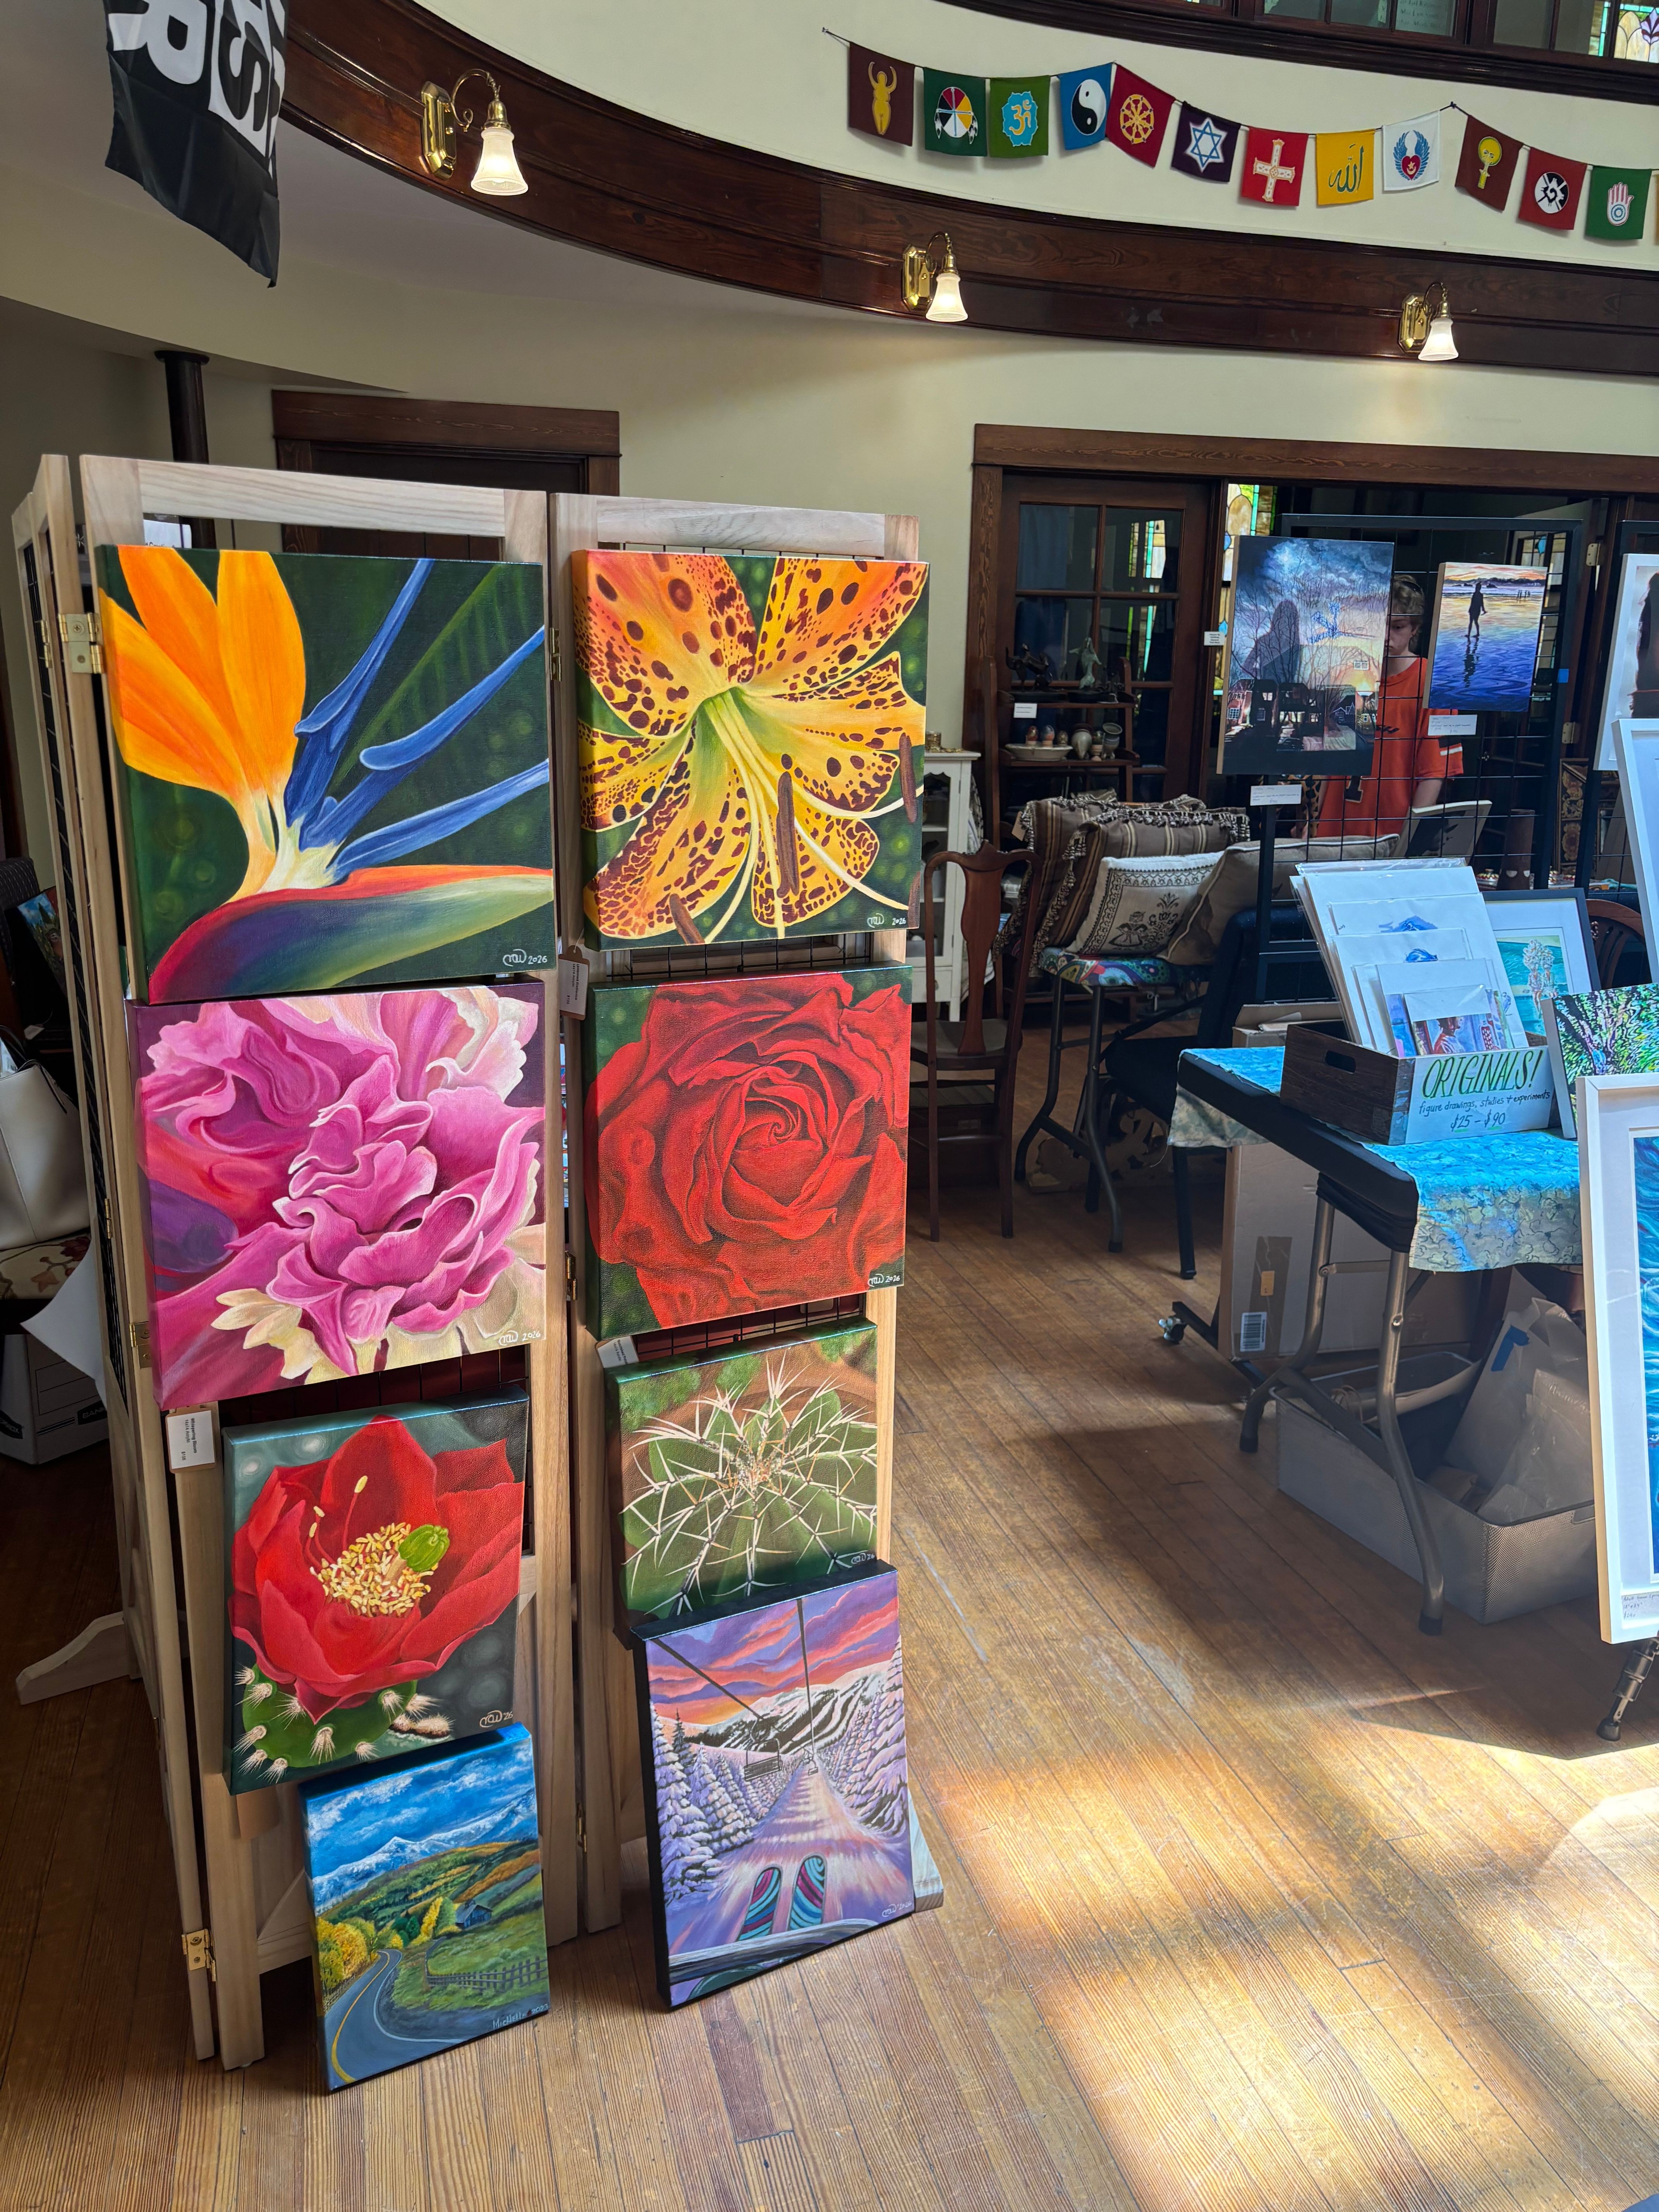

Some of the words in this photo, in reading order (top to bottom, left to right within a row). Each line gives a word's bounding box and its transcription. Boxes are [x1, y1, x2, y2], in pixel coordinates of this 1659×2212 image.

[528, 955, 548, 964] 2026
[1422, 1050, 1543, 1098] ORIGINALS!
[1419, 1101, 1443, 1116] figure
[1444, 1101, 1477, 1112] drawings,
[1479, 1096, 1504, 1107] studies
[1513, 1090, 1550, 1105] experiments
[1450, 1114, 1473, 1132] $25
[1484, 1109, 1505, 1128] $90
[522, 1331, 541, 1341] 2026
